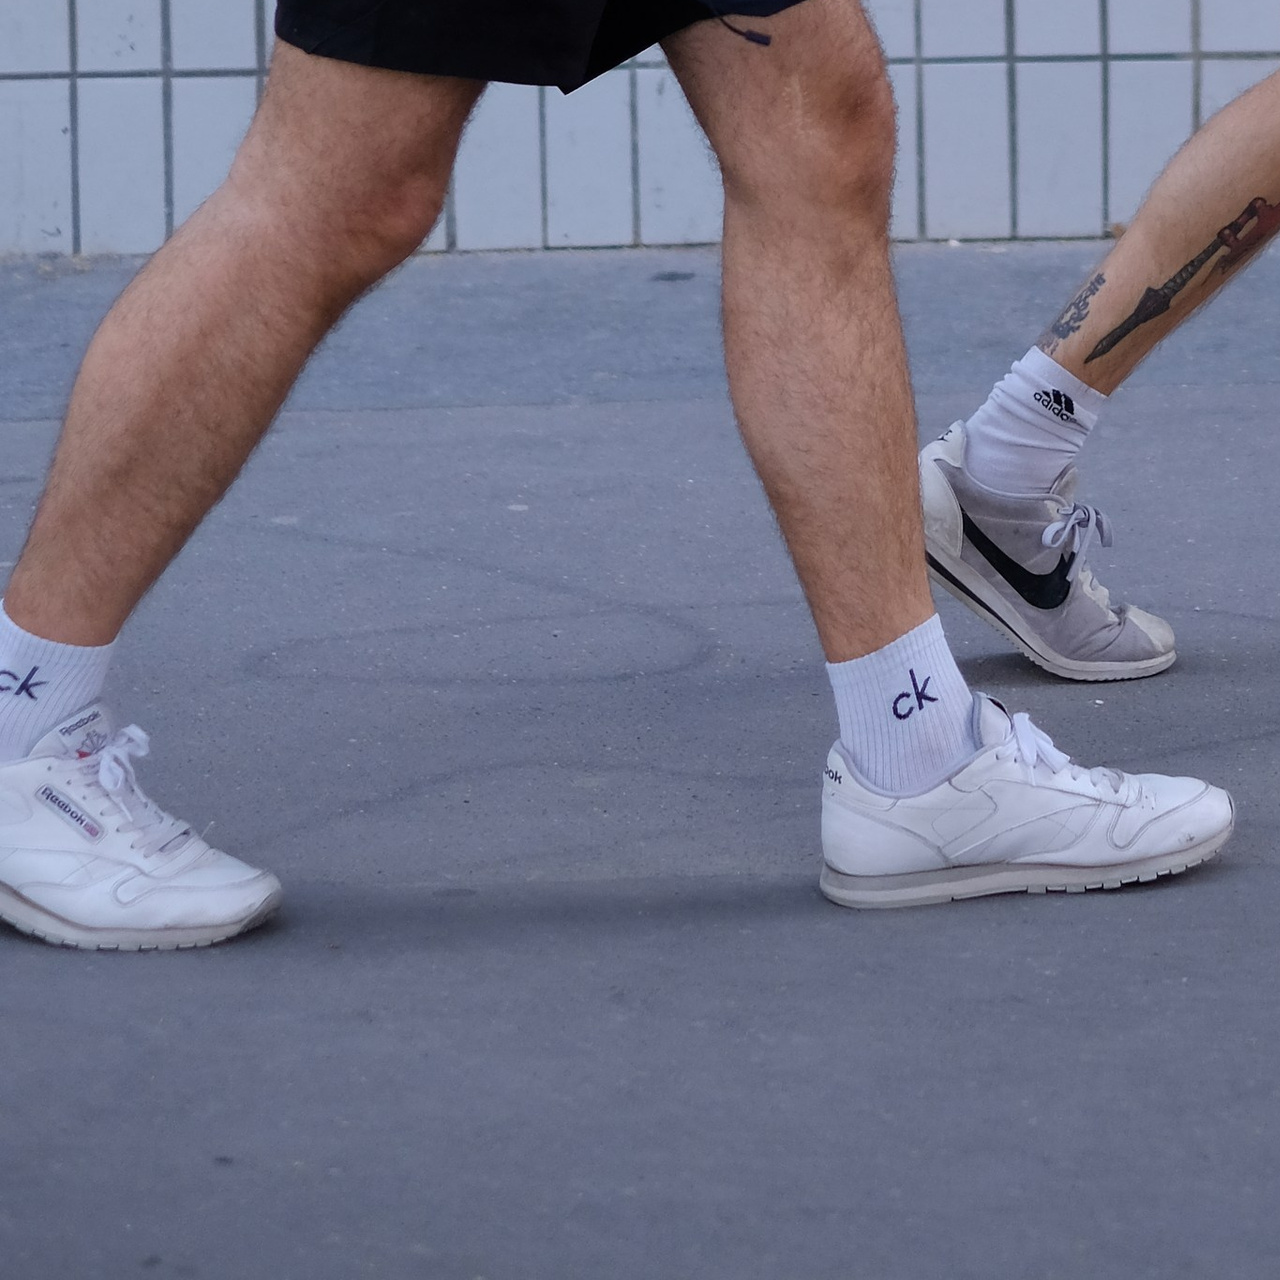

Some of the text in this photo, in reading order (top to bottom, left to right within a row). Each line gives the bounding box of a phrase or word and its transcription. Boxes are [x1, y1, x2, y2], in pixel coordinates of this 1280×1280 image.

[0, 666, 48, 701] ck
[892, 668, 938, 720] ck
[59, 711, 101, 736] Reebok
[41, 787, 87, 826] Reebok
